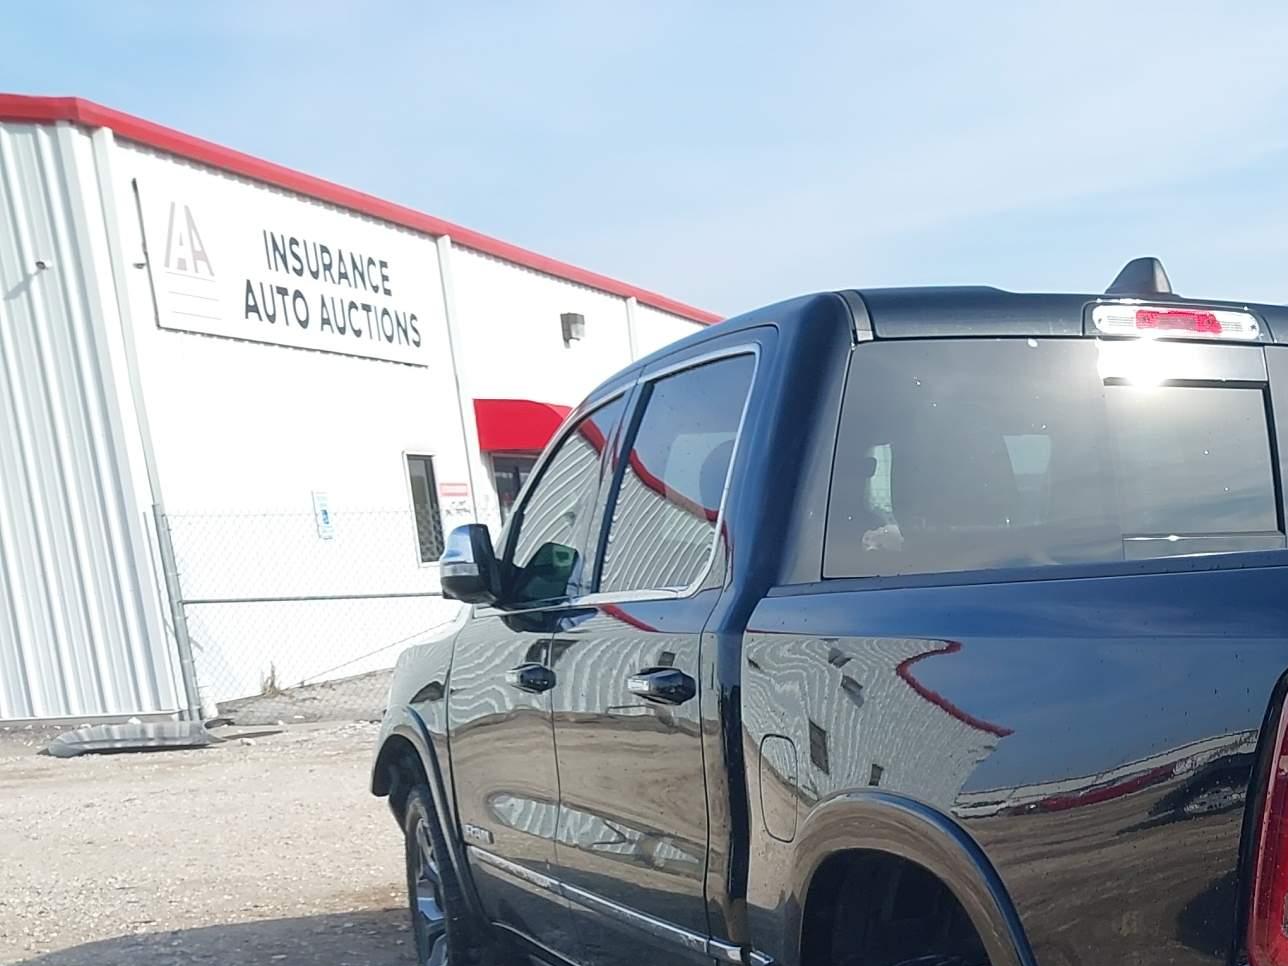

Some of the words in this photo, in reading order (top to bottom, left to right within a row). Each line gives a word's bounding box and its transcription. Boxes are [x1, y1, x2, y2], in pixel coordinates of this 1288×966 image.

[263, 229, 392, 296] INSURANCE
[245, 279, 309, 329] AUTO
[320, 294, 421, 348] AUCTIONS
